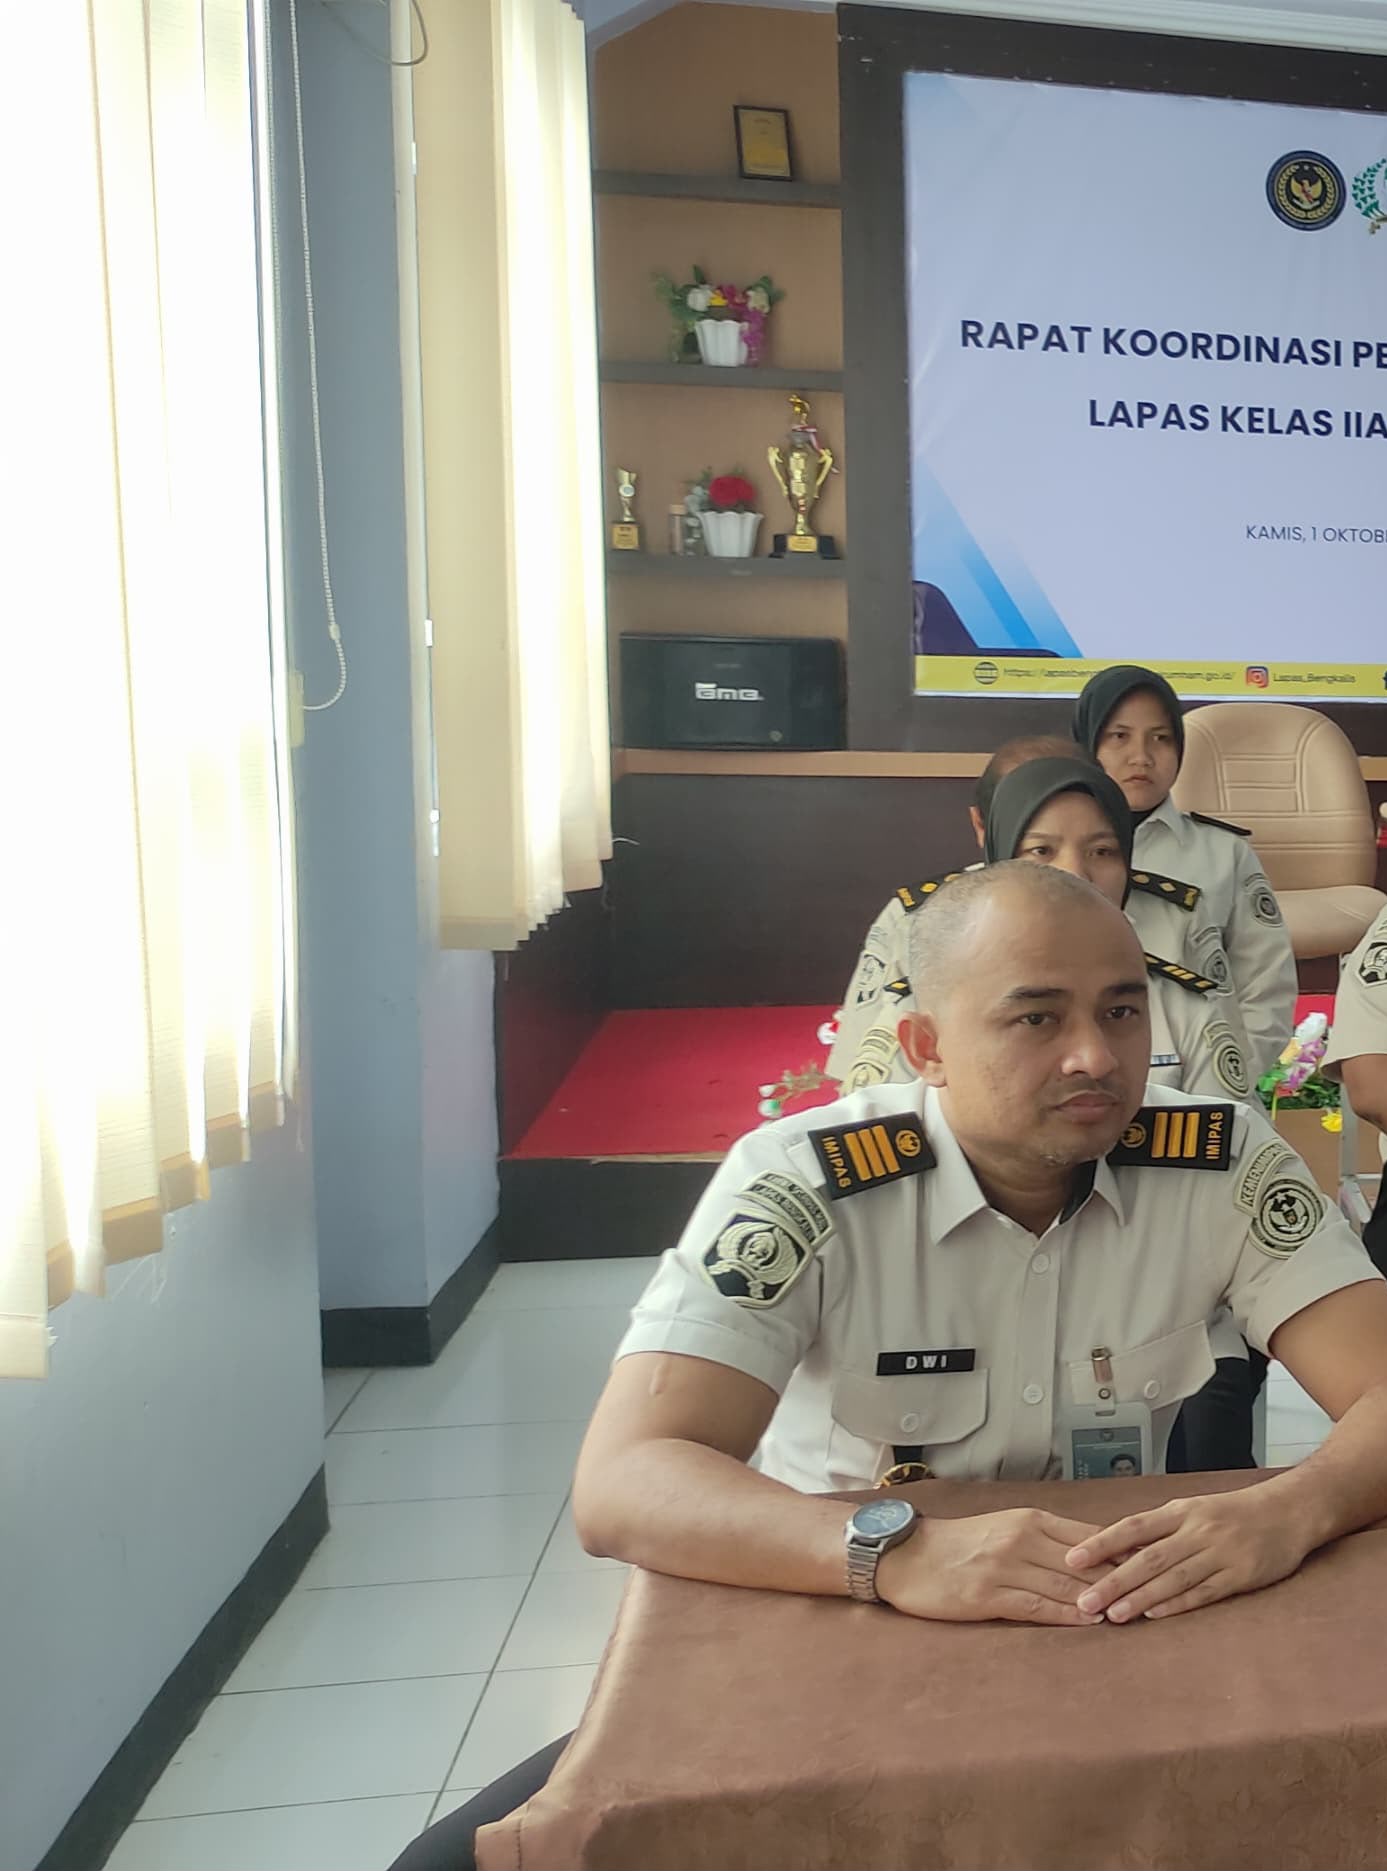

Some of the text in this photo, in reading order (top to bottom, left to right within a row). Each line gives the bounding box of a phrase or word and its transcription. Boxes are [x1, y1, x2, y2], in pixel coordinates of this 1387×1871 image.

[962, 320, 1092, 354] RAPAT
[1104, 328, 1342, 367] KOORDINASI
[1090, 400, 1210, 432] LAPAS
[1222, 406, 1333, 437] KELAS
[1246, 525, 1307, 544] KAMIS,
[1311, 526, 1317, 541] 1
[1204, 1112, 1224, 1160] IMIPAS
[821, 1136, 852, 1189] IMIPAS
[905, 1354, 948, 1371] DWI
